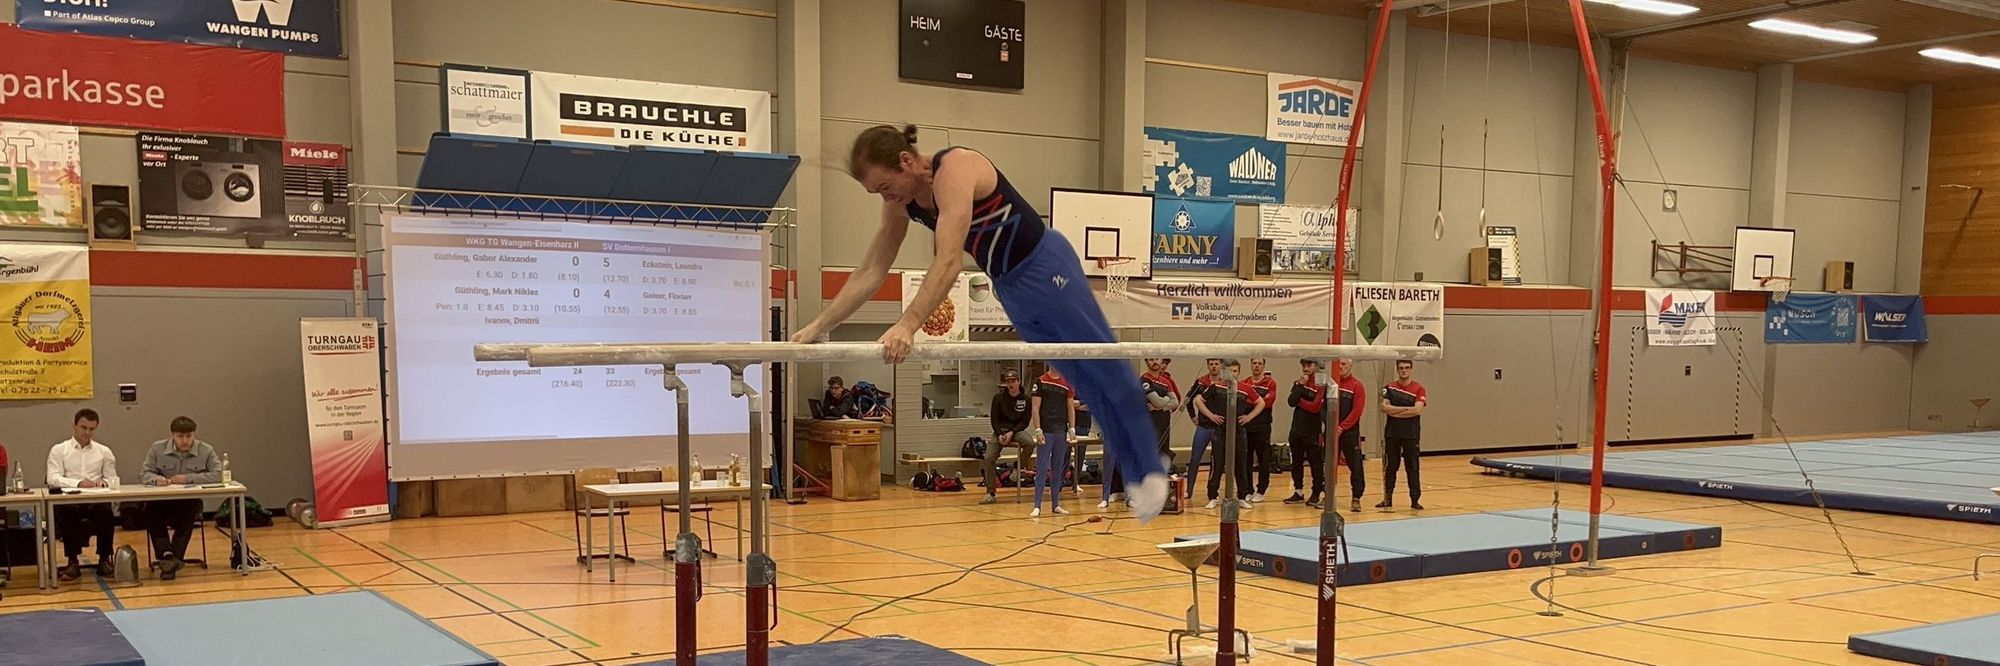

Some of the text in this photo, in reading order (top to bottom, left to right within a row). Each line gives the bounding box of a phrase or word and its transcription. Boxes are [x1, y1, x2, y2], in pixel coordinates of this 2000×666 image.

[53, 11, 70, 19] Part
[82, 13, 102, 21] Atlas
[104, 15, 129, 24] Copco
[131, 18, 155, 27] Group
[910, 15, 941, 31] HEIM
[206, 22, 319, 43] WANGEN PUMPS
[984, 24, 1022, 41] GÄSTE
[0, 69, 165, 109] parkasse
[450, 81, 523, 100] schattmaier
[1278, 88, 1353, 117] JARDE
[574, 100, 734, 126] BRAUCHLE
[1277, 117, 1301, 127] Besser
[1303, 120, 1324, 128] bauen
[1325, 122, 1336, 130] mit
[142, 134, 208, 145] Die Firma Knoblauch
[621, 129, 734, 145] DIE KÜCHE
[174, 153, 199, 161] Experte
[290, 147, 339, 160] Miele
[1229, 147, 1277, 180] WALDNER
[288, 214, 346, 224] KNOBLAUCH
[466, 237, 485, 245] WKG
[488, 238, 499, 246] TG
[500, 238, 572, 249] Wangen-Eisenharz
[602, 242, 613, 250] SV
[1153, 233, 1218, 255] ARNY
[472, 253, 496, 262] Gabor
[499, 254, 538, 264] Alexander
[572, 256, 579, 266] 0
[603, 257, 610, 267] 5
[1179, 257, 1191, 265] und
[1192, 257, 1208, 265] mehr
[0, 265, 39, 277] rgenbühl
[492, 287, 513, 295] Mark
[514, 287, 539, 296] Niklas
[573, 288, 580, 298] 0
[603, 289, 610, 298] 4
[1156, 283, 1293, 298] Herzlich willkommen
[1355, 286, 1440, 302] FLIESEN BARETH
[12, 290, 86, 330] Allgäuer Dorfmetzgerei
[1195, 303, 1230, 311] Volksbank
[1195, 312, 1267, 322] Allgäu-Oberschwaben
[307, 335, 360, 344] TURNGAU
[308, 344, 362, 352] OBERSCHWABEN
[43, 359, 88, 368] Partyservice
[476, 368, 541, 377] Ergebnis gesamt
[573, 367, 583, 375] 24
[605, 367, 615, 375] 33
[312, 390, 324, 398] Wir
[1707, 481, 1733, 490] SPIETH
[1958, 505, 1992, 514] SPIETH
[1242, 557, 1264, 568] SPIETH
[1325, 543, 1336, 584] SPIETH
